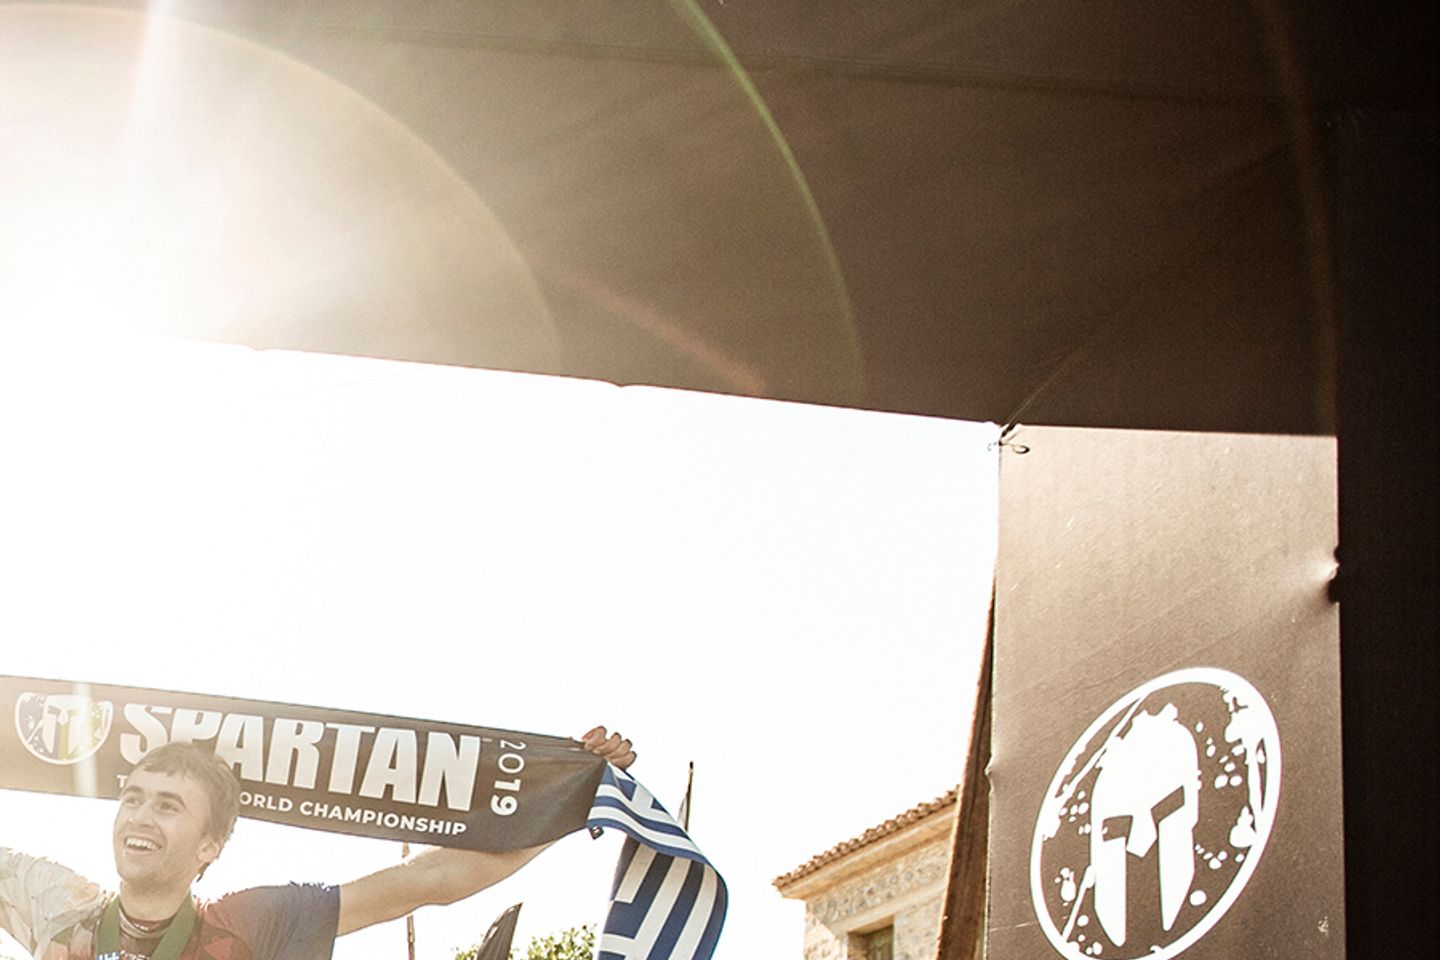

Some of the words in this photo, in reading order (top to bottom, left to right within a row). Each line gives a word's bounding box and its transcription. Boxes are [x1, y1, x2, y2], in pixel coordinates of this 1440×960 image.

[120, 703, 481, 811] SPARTAN
[490, 739, 527, 816] 2019
[240, 791, 293, 813] ORLD
[299, 801, 467, 836] CHAMPIONSHIP
